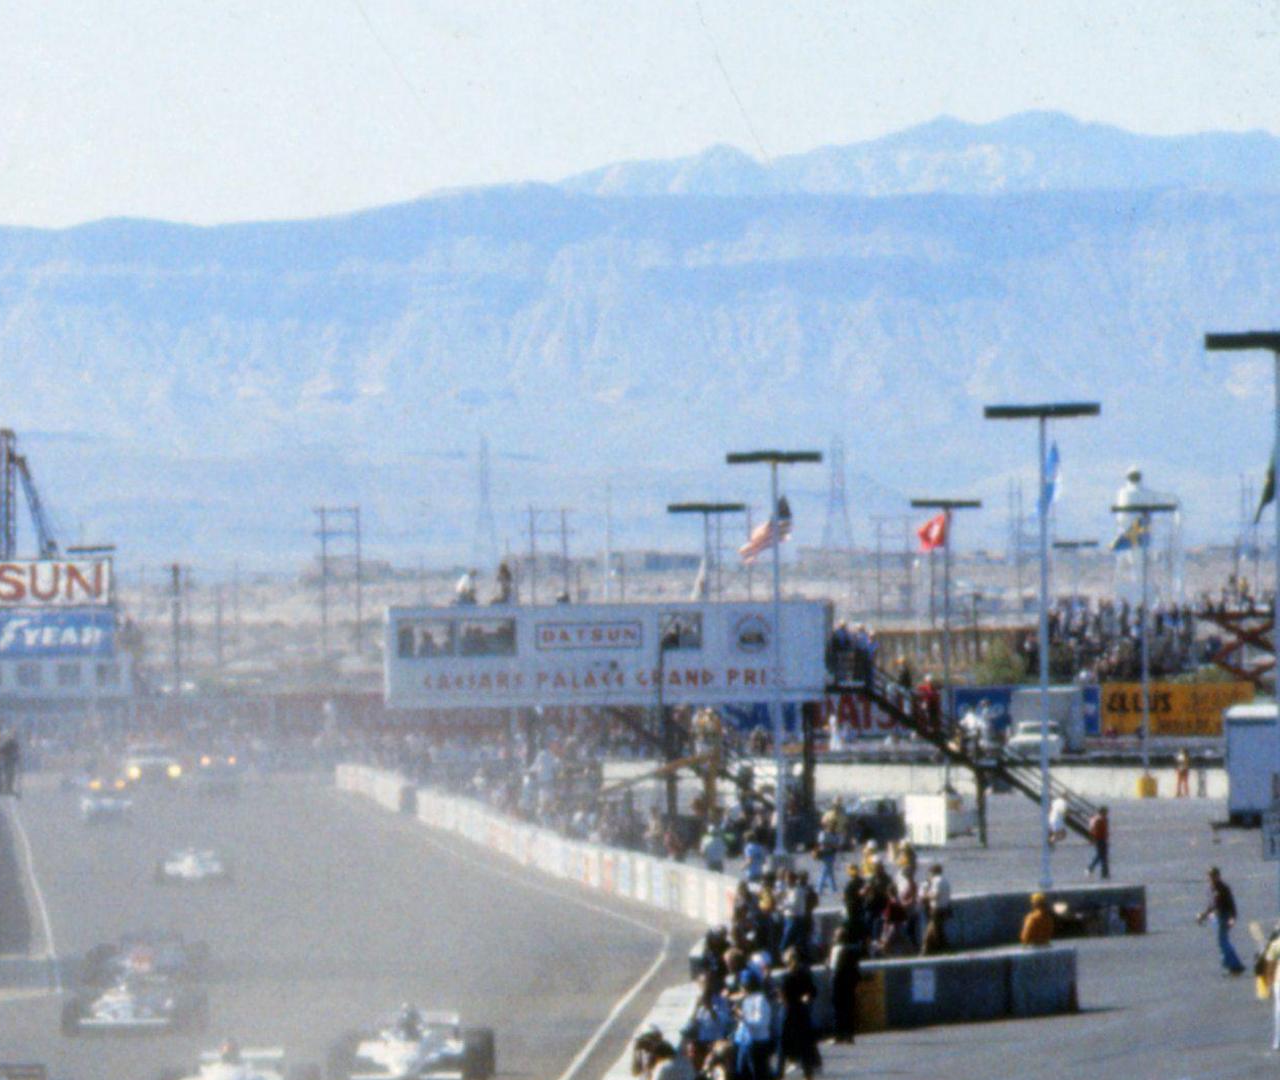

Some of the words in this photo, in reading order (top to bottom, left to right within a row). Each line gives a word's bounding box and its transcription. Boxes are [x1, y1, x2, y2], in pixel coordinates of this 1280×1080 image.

[542, 629, 637, 643] DATSUN
[423, 671, 524, 690] CAESARS
[537, 669, 626, 690] PALACE
[637, 667, 714, 689] GRAND
[725, 666, 784, 686] PRIX
